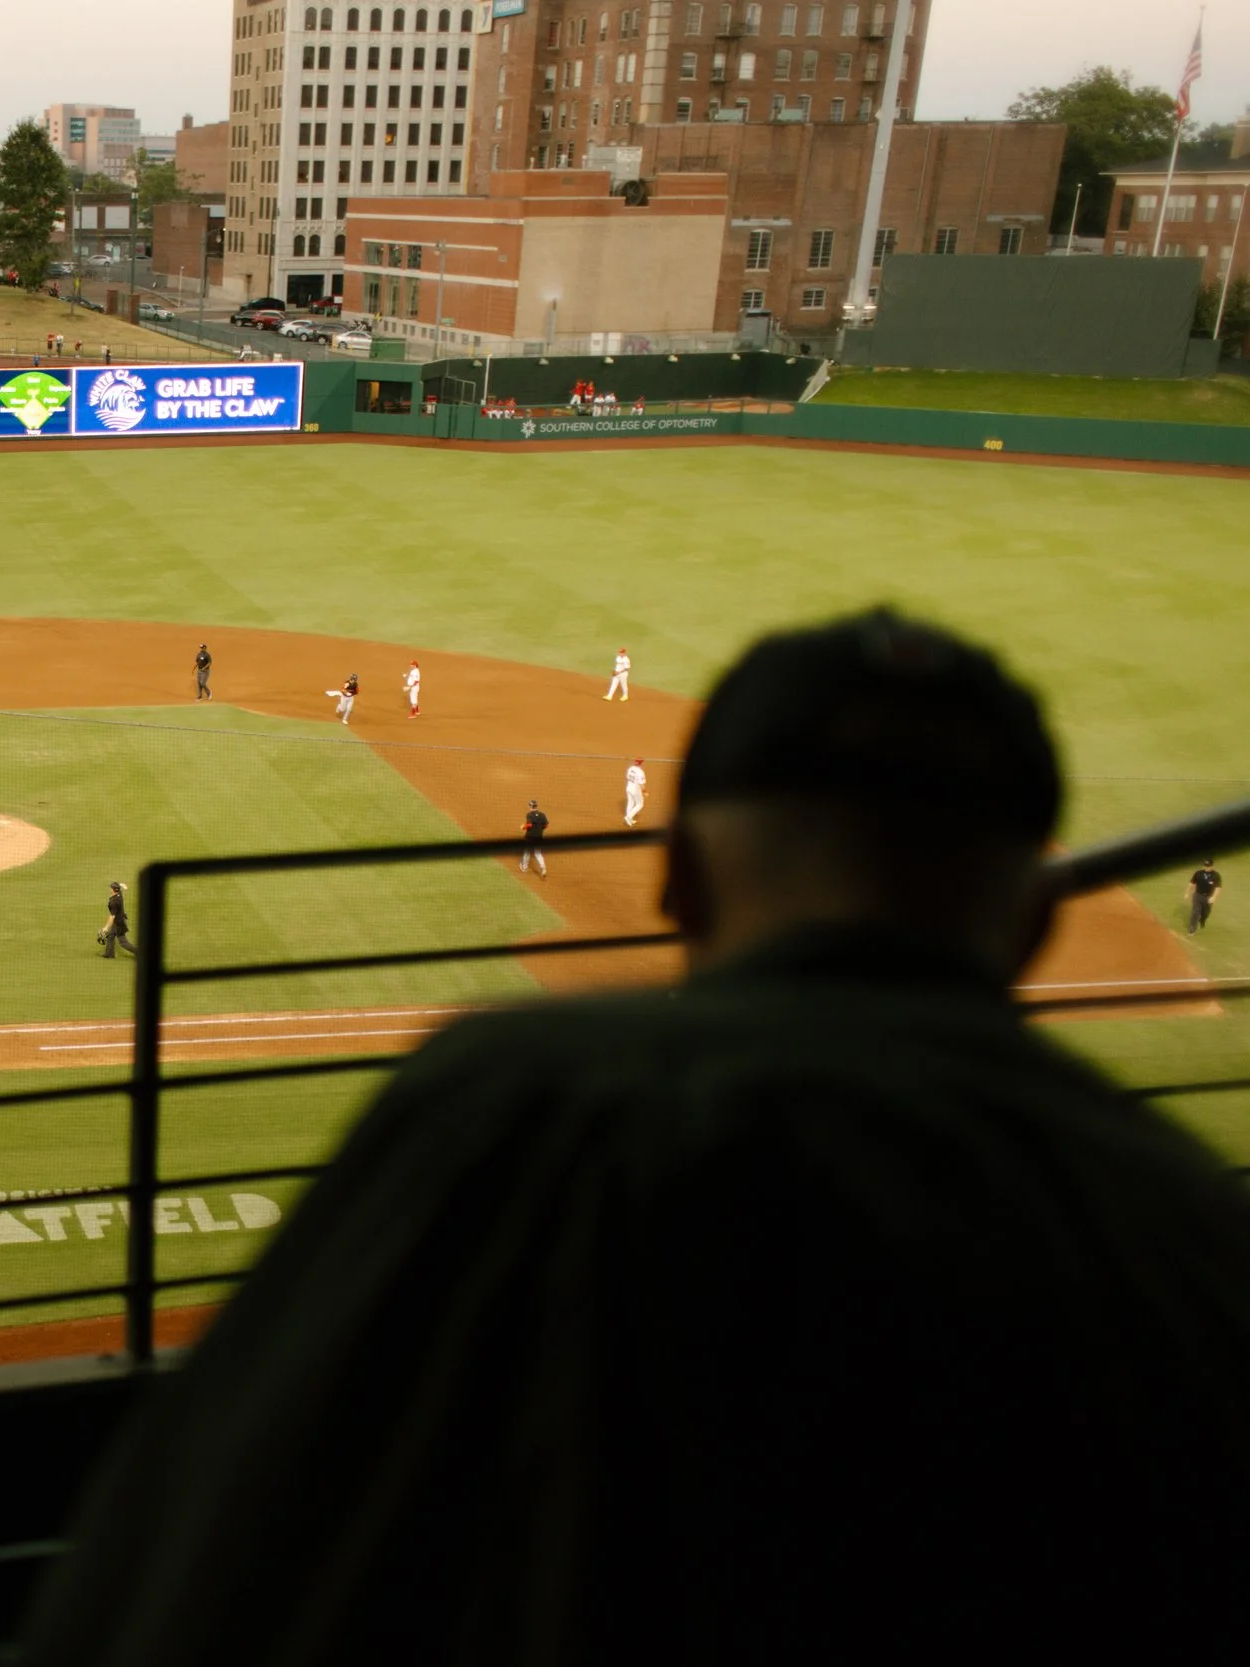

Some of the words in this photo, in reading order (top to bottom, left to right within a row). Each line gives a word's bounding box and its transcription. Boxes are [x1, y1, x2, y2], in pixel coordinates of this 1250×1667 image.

[89, 371, 114, 407] WHITE
[116, 369, 146, 391] CLAW
[157, 378, 212, 398] GRAB
[215, 377, 255, 396] LIFE
[157, 400, 182, 419] BY
[185, 400, 222, 418] THE
[540, 421, 594, 433] SOUTHERN
[595, 420, 640, 431] COLLEGE
[642, 419, 655, 430] OF
[658, 418, 717, 429] OPTOMETRY
[983, 439, 1003, 450] 400
